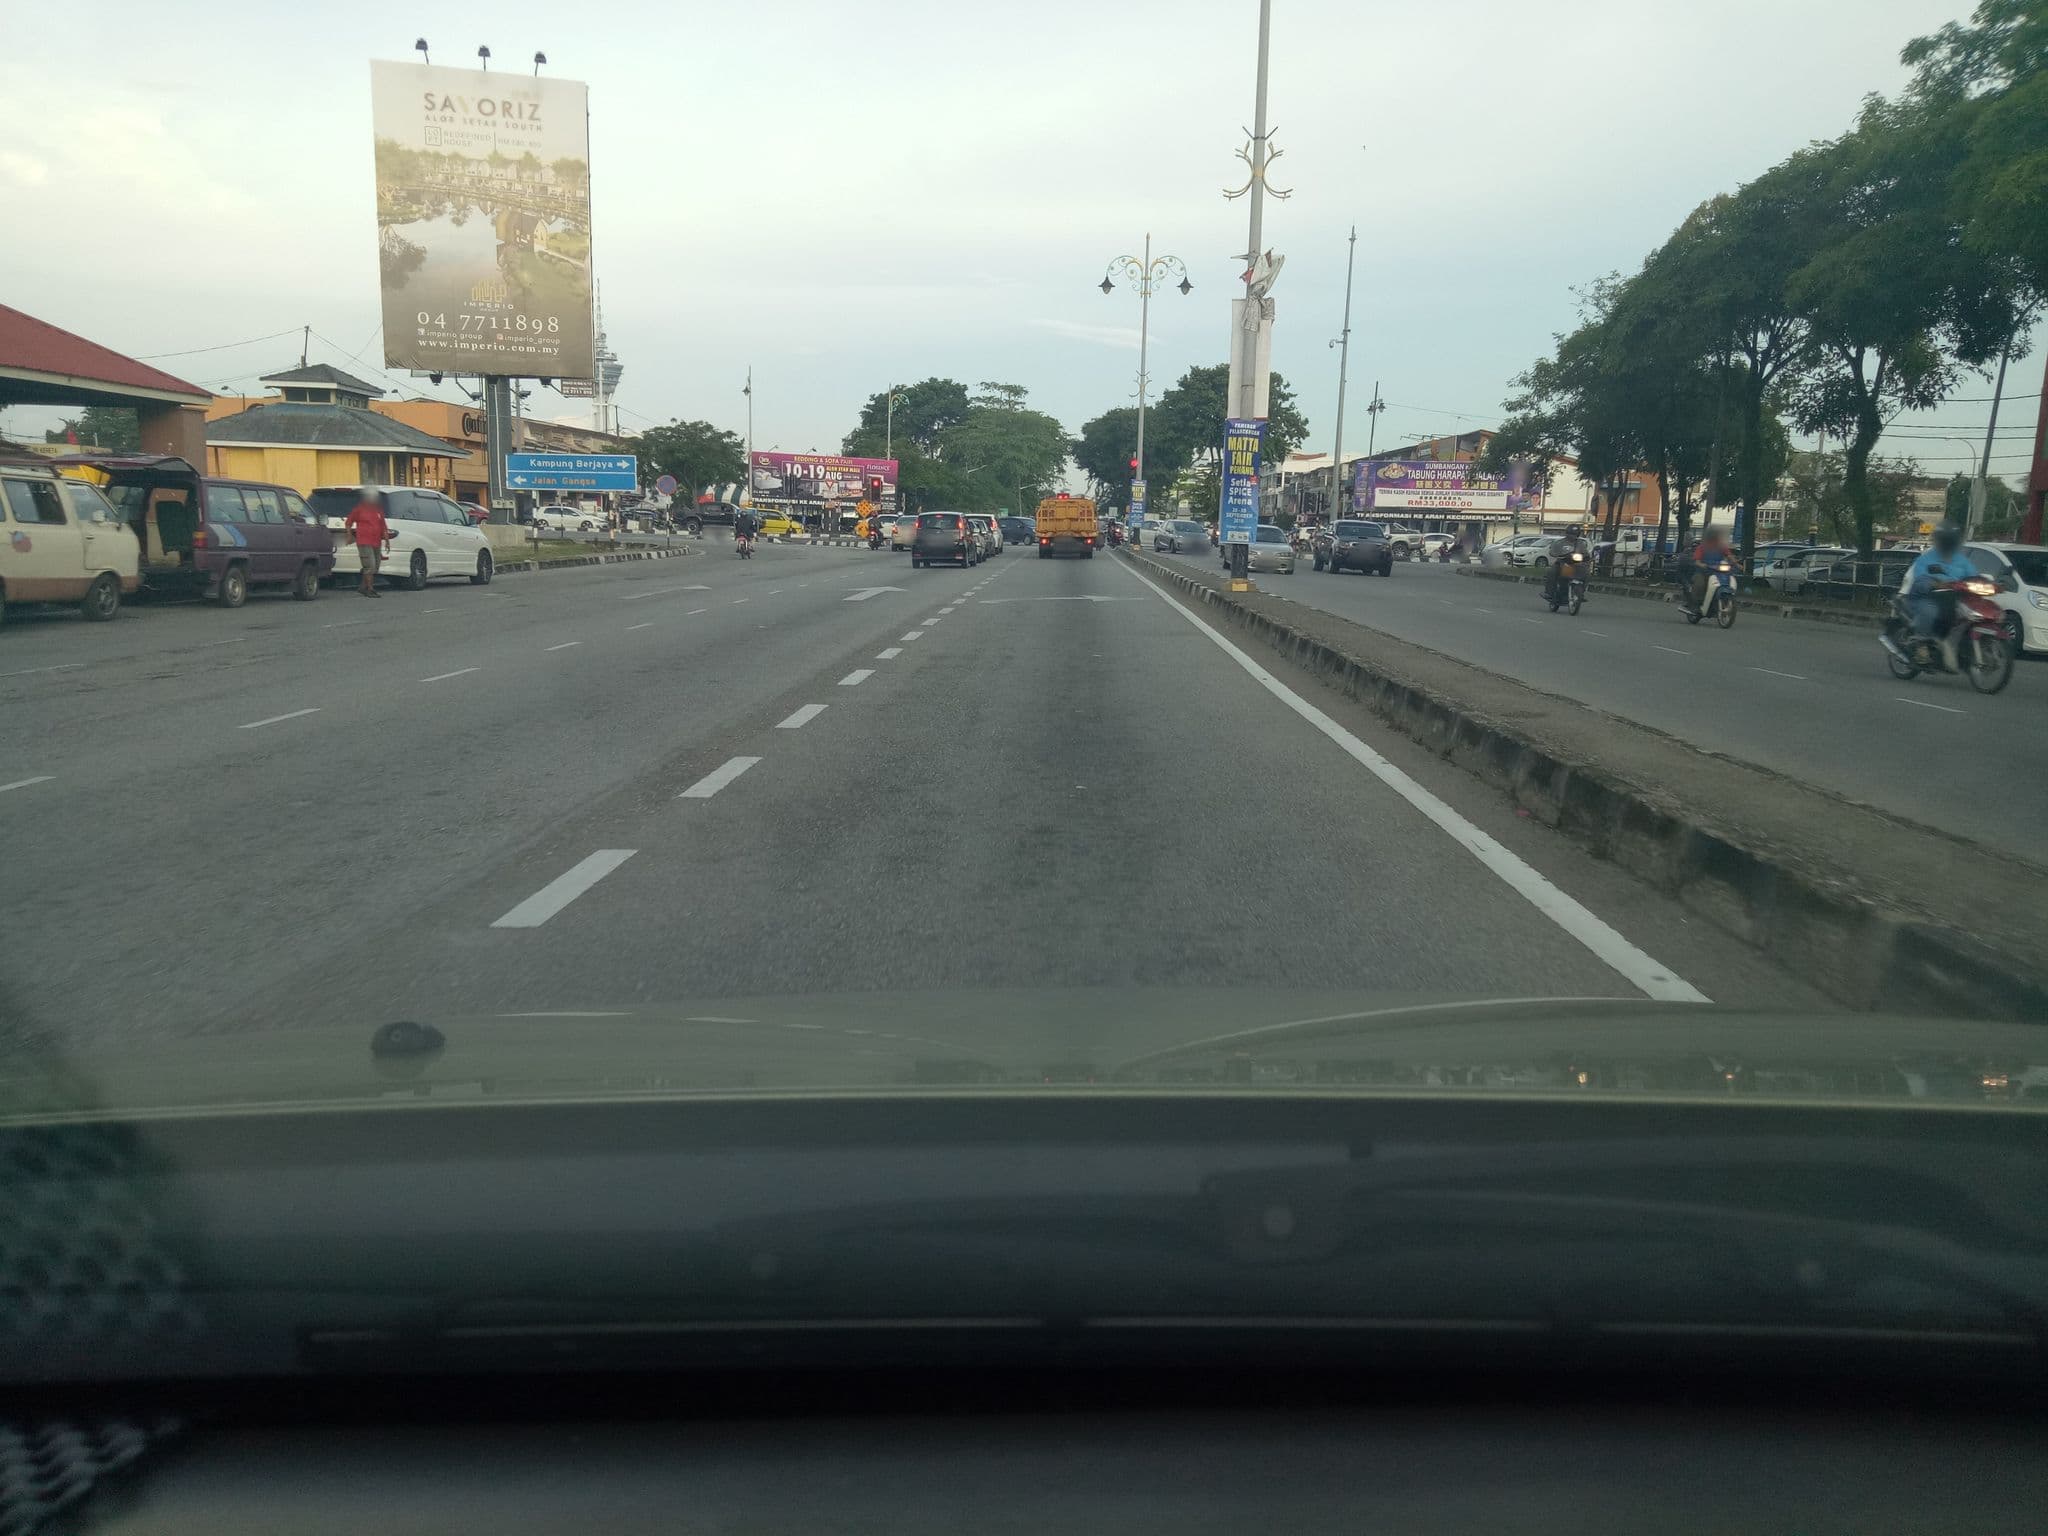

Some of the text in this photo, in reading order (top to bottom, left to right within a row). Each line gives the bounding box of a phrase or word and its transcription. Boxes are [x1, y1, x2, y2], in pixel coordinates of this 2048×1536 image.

[504, 121, 542, 132] SOUTH
[463, 301, 514, 310] IMPERIO
[417, 311, 559, 334] 04 7711898
[418, 338, 560, 355] www.imperio.com.my
[1228, 437, 1259, 453] MATTA
[1232, 452, 1252, 465] FAIR
[530, 458, 613, 470] Kampung Berjaya
[786, 463, 825, 479] 10-19
[825, 472, 843, 480] AUG
[1230, 466, 1254, 475] PENANG
[1407, 470, 1436, 480] TABUNG
[531, 476, 557, 486] Jalan
[1231, 478, 1251, 487] Setia
[1229, 487, 1252, 496] SPICE
[1228, 497, 1252, 506] Arena
